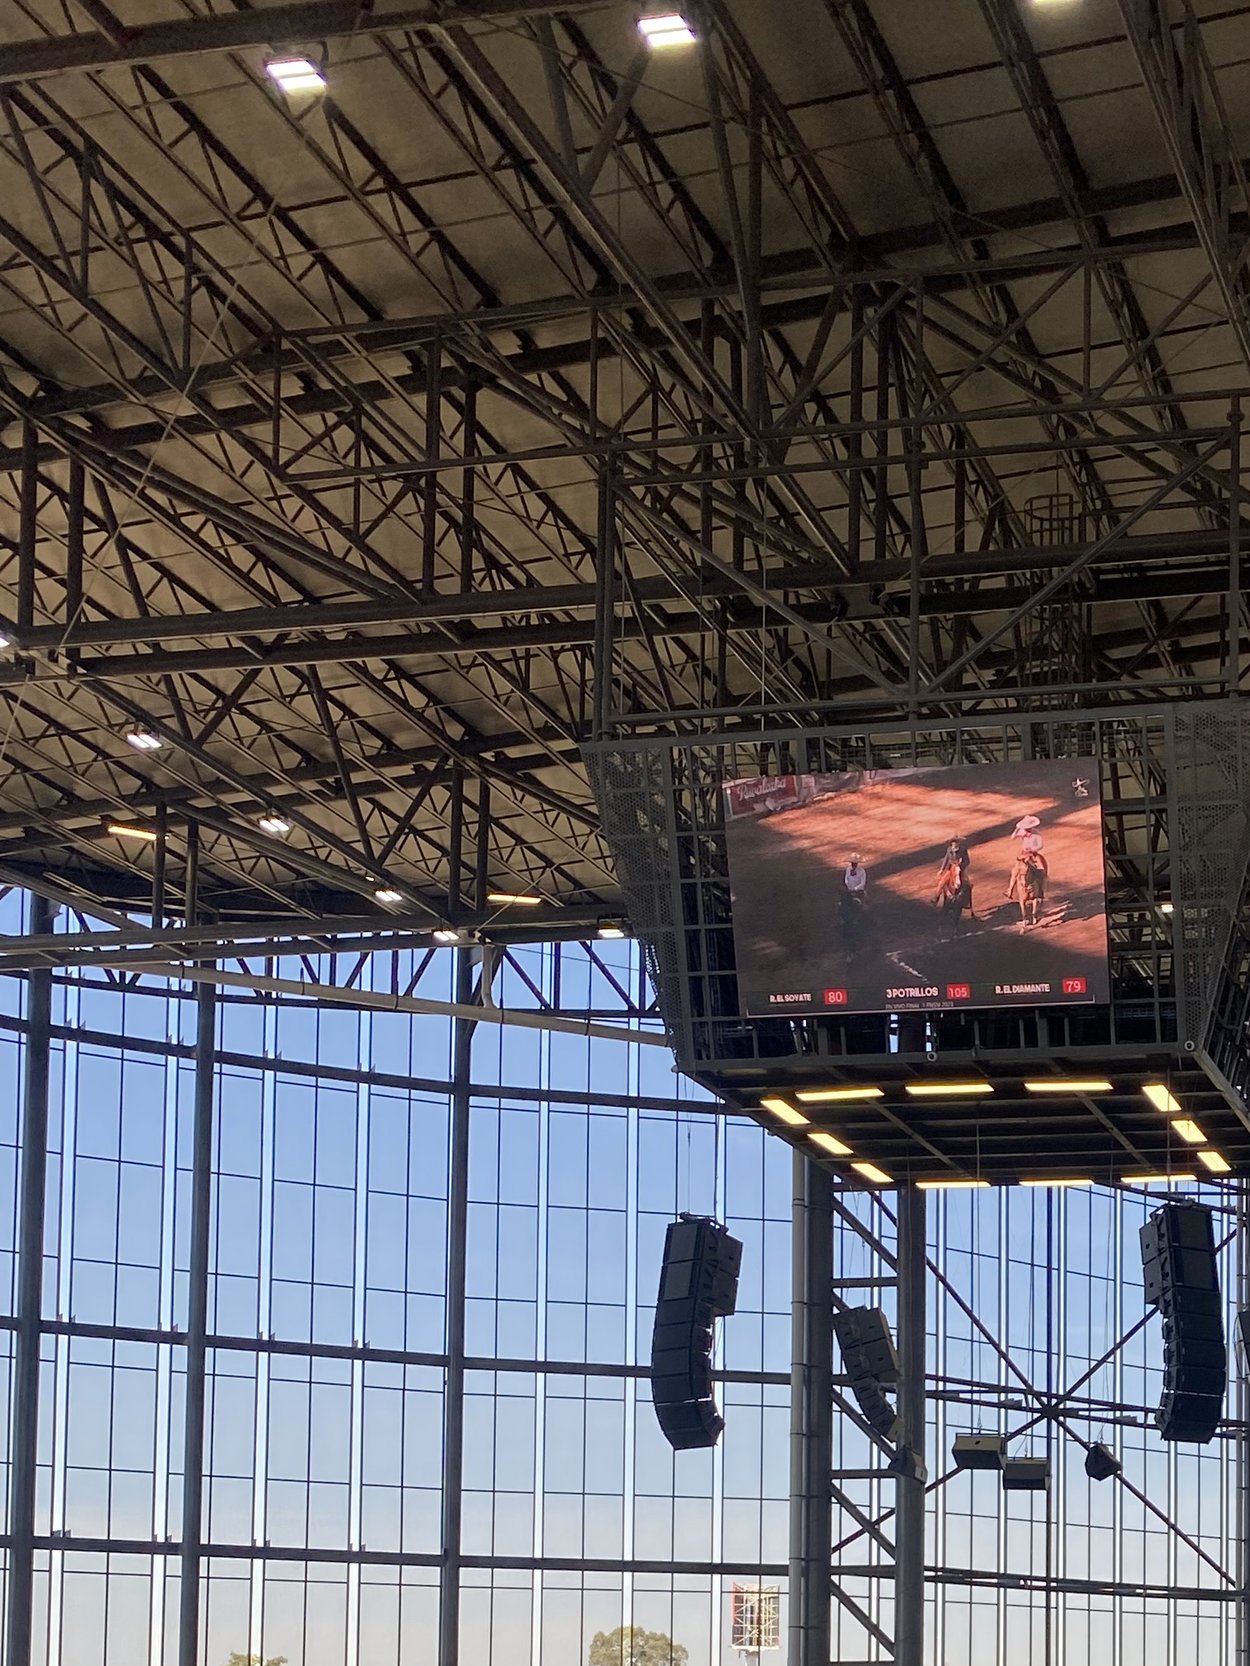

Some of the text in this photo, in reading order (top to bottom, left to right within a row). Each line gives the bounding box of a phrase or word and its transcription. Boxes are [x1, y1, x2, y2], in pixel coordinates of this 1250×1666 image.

[1066, 981, 1081, 992] 79
[828, 991, 843, 1003] 80
[948, 987, 968, 998] 105
